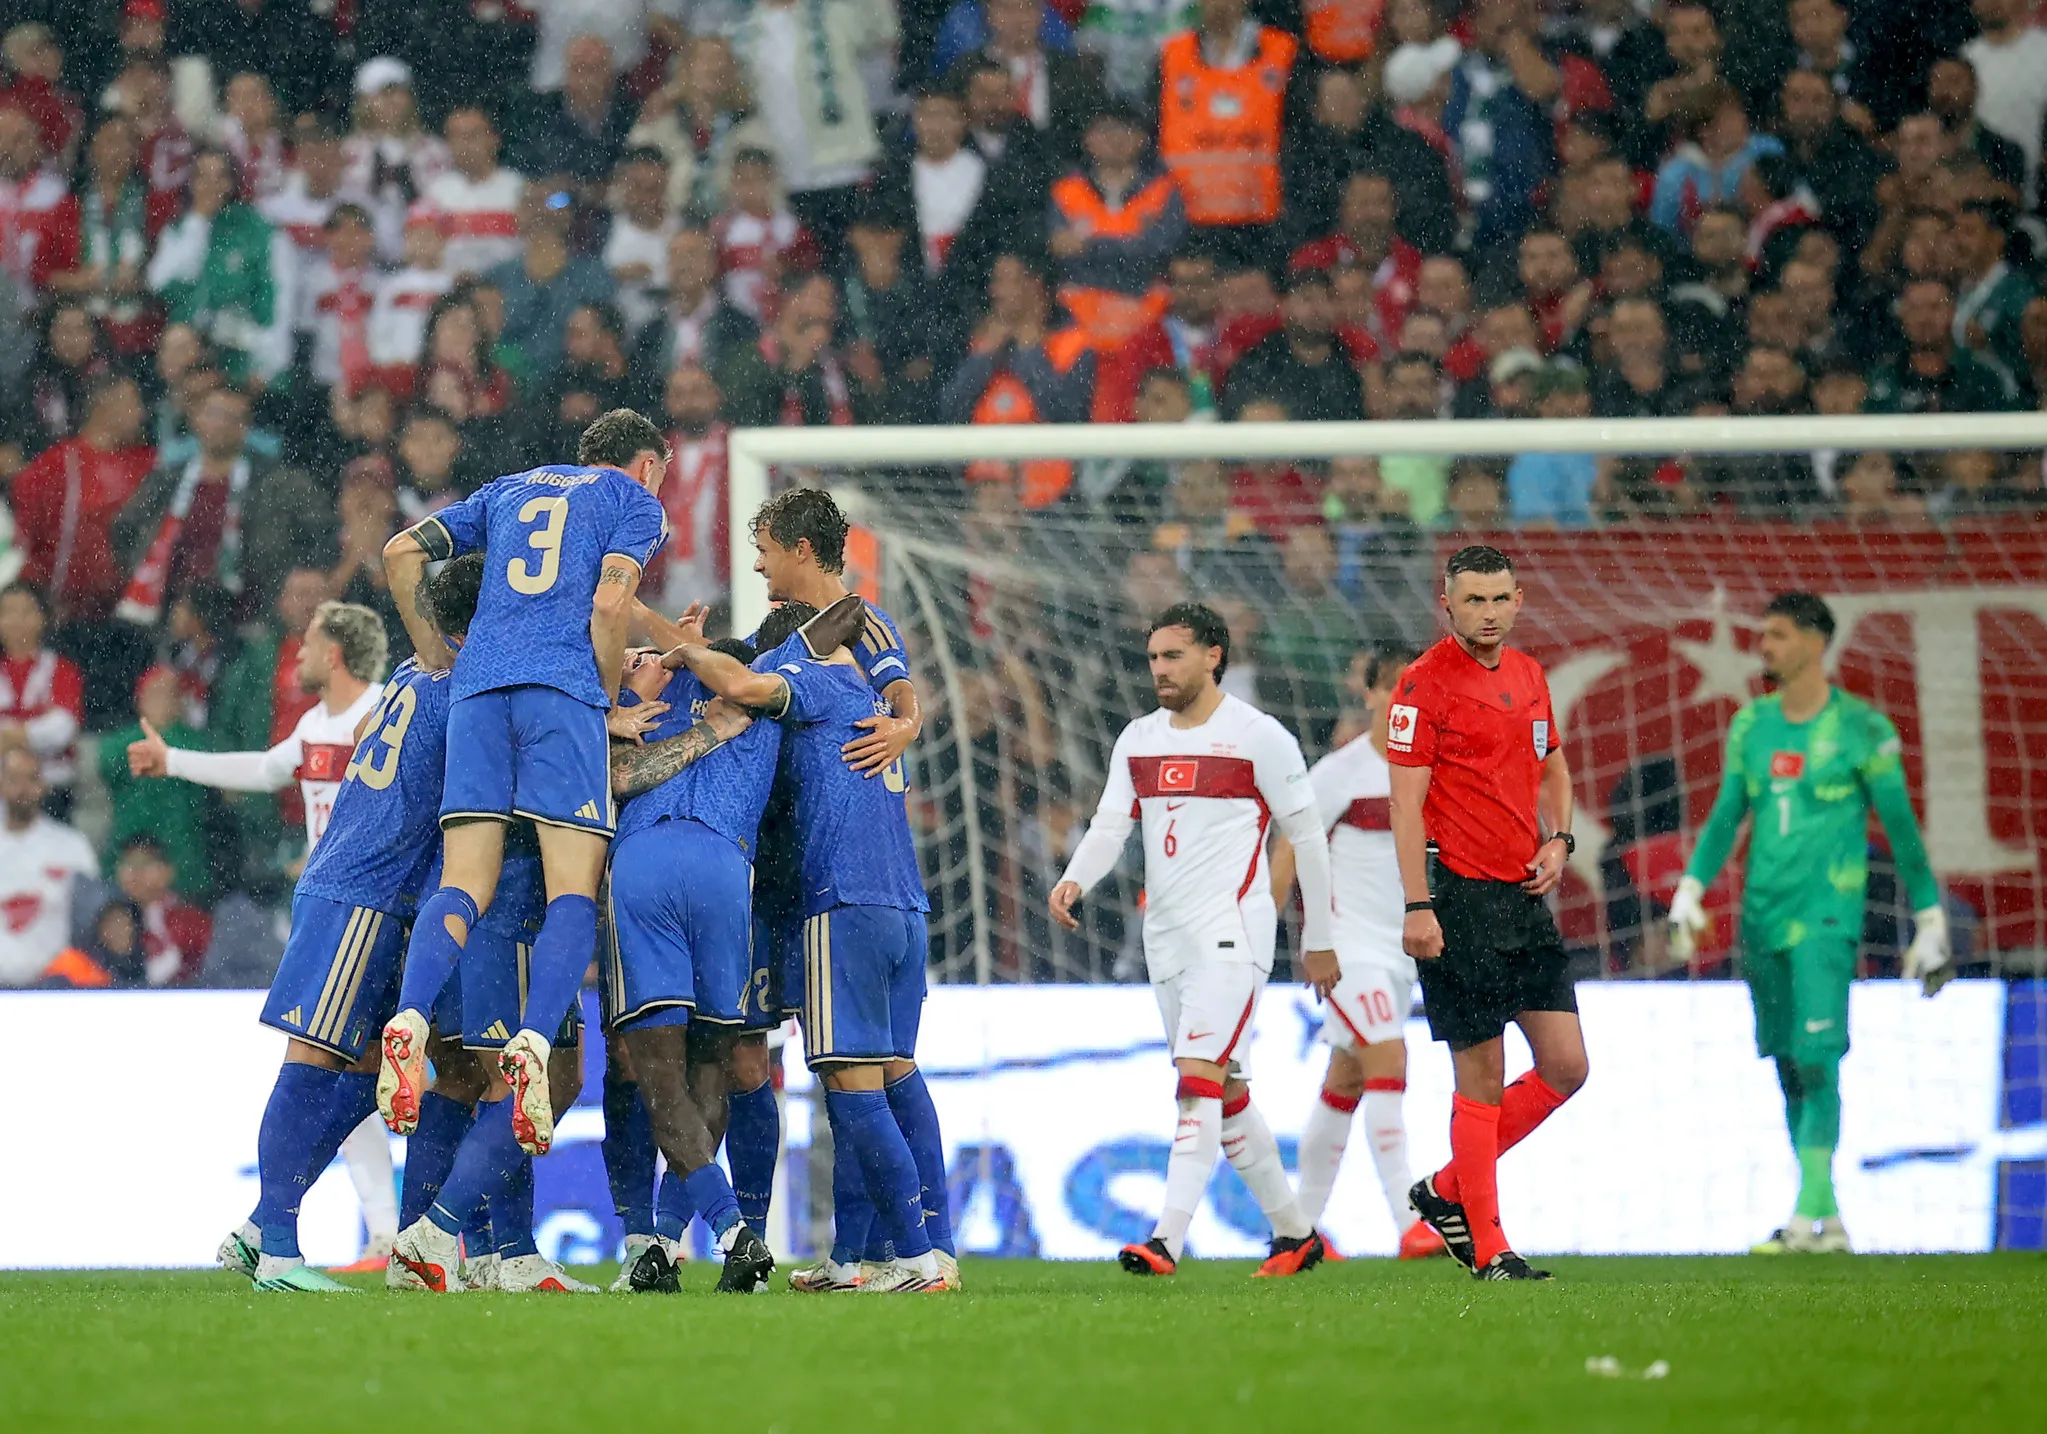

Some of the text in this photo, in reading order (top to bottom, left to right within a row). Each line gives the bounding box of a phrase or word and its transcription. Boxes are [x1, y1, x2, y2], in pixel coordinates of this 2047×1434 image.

[525, 472, 601, 488] RUGGERI
[507, 496, 569, 595] 3
[345, 680, 417, 791] 23
[1777, 795, 1791, 837] 1
[1164, 819, 1178, 857] 6
[1356, 989, 1393, 1027] 10
